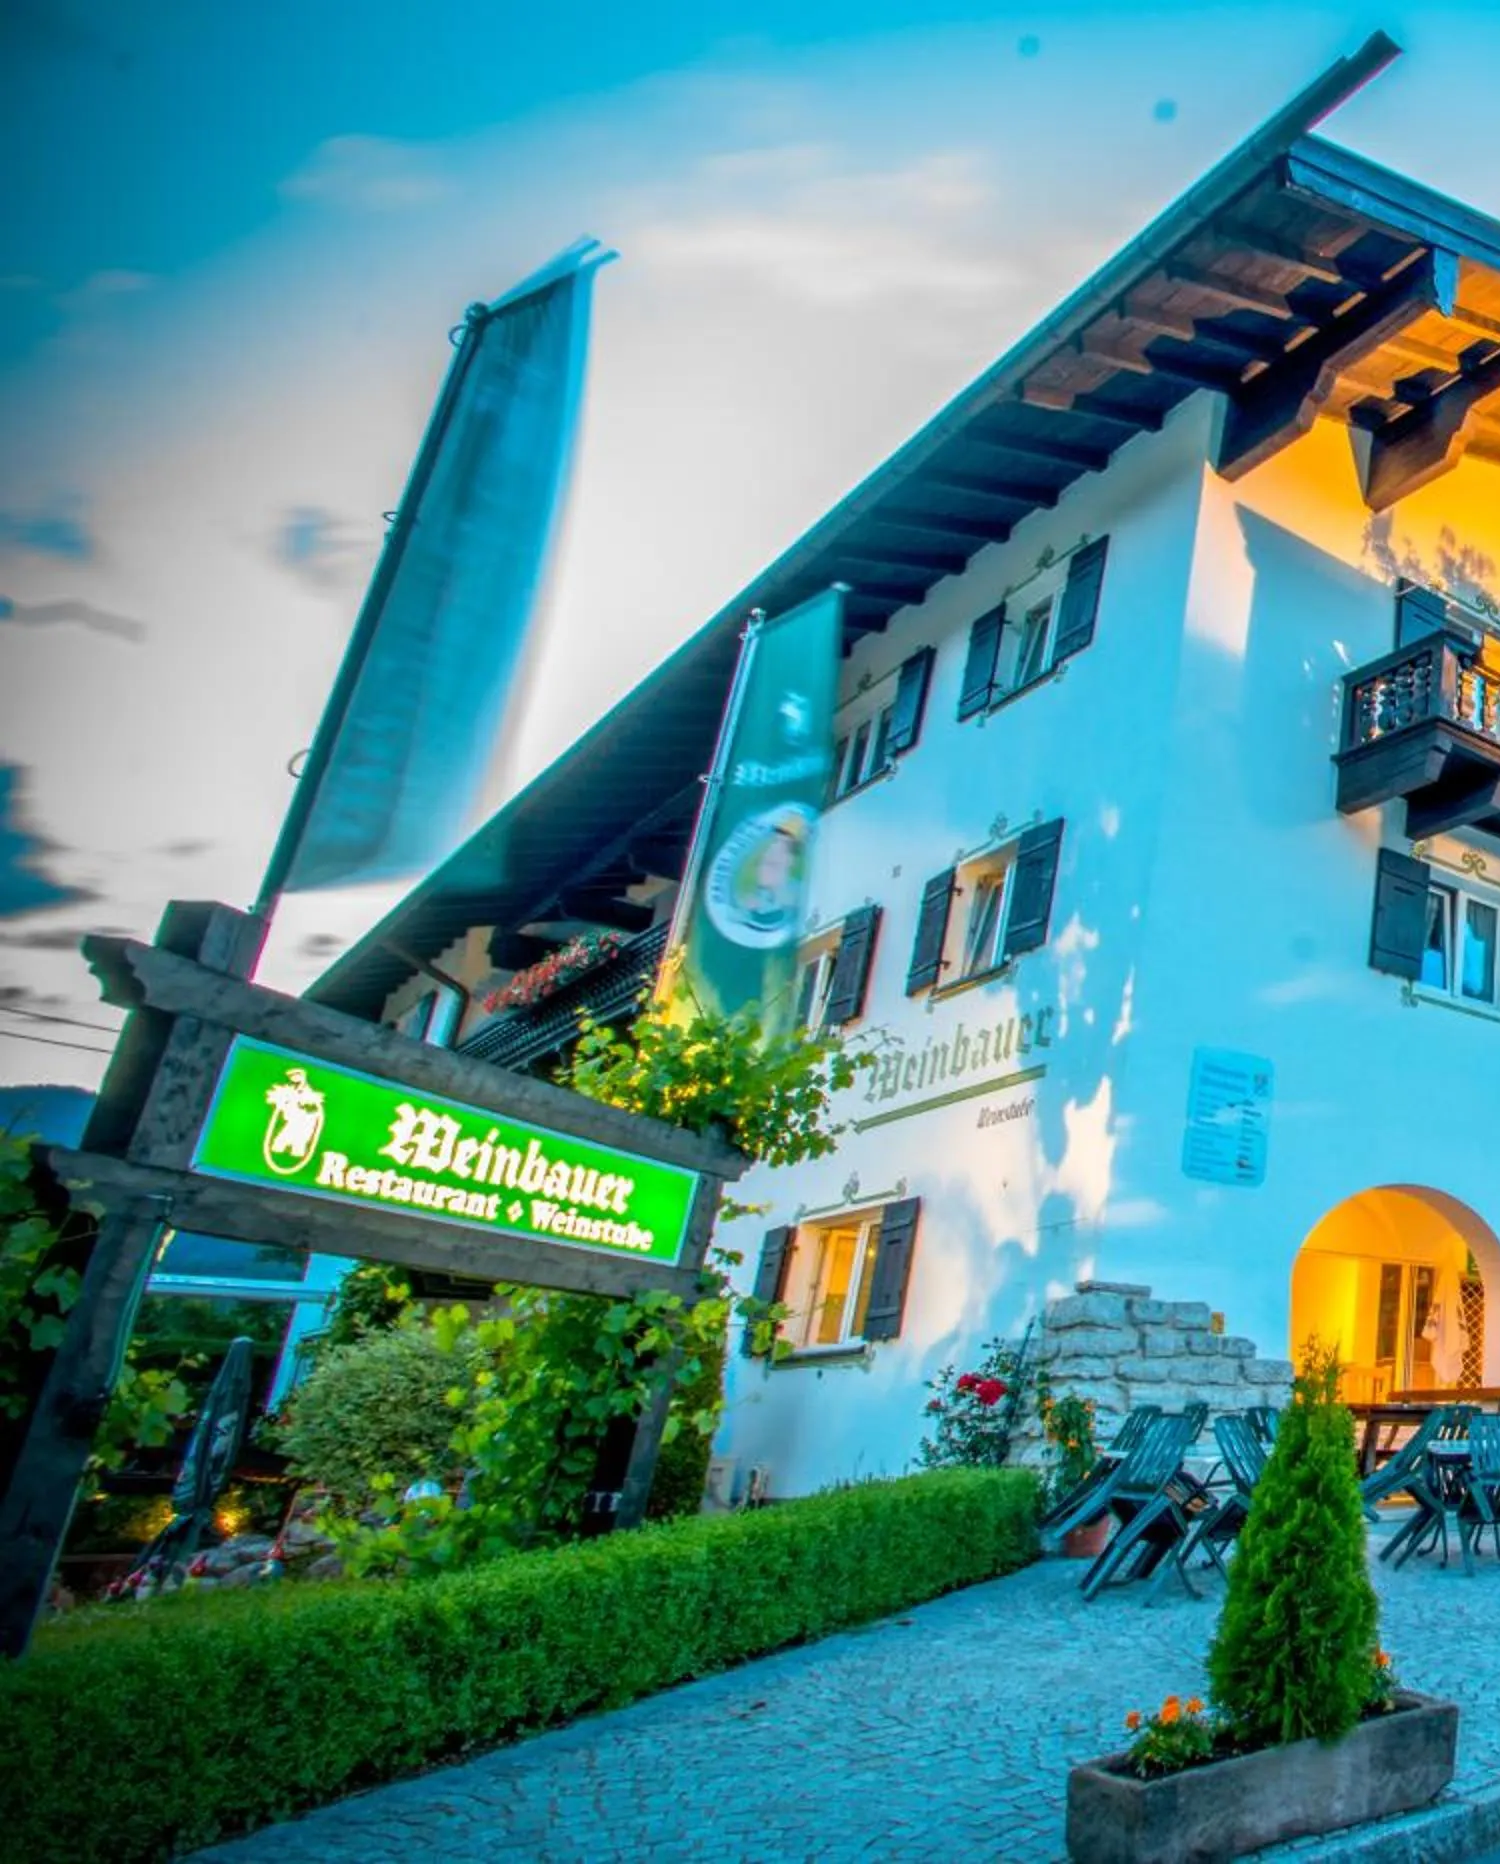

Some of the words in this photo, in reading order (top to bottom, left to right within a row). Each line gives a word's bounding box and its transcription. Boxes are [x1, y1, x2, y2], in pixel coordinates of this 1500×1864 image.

[864, 1006, 1054, 1103] Weinbauer
[315, 1150, 502, 1220] Restaurant
[530, 1199, 655, 1252] Weinstube
[377, 1102, 635, 1215] Weinbauer
